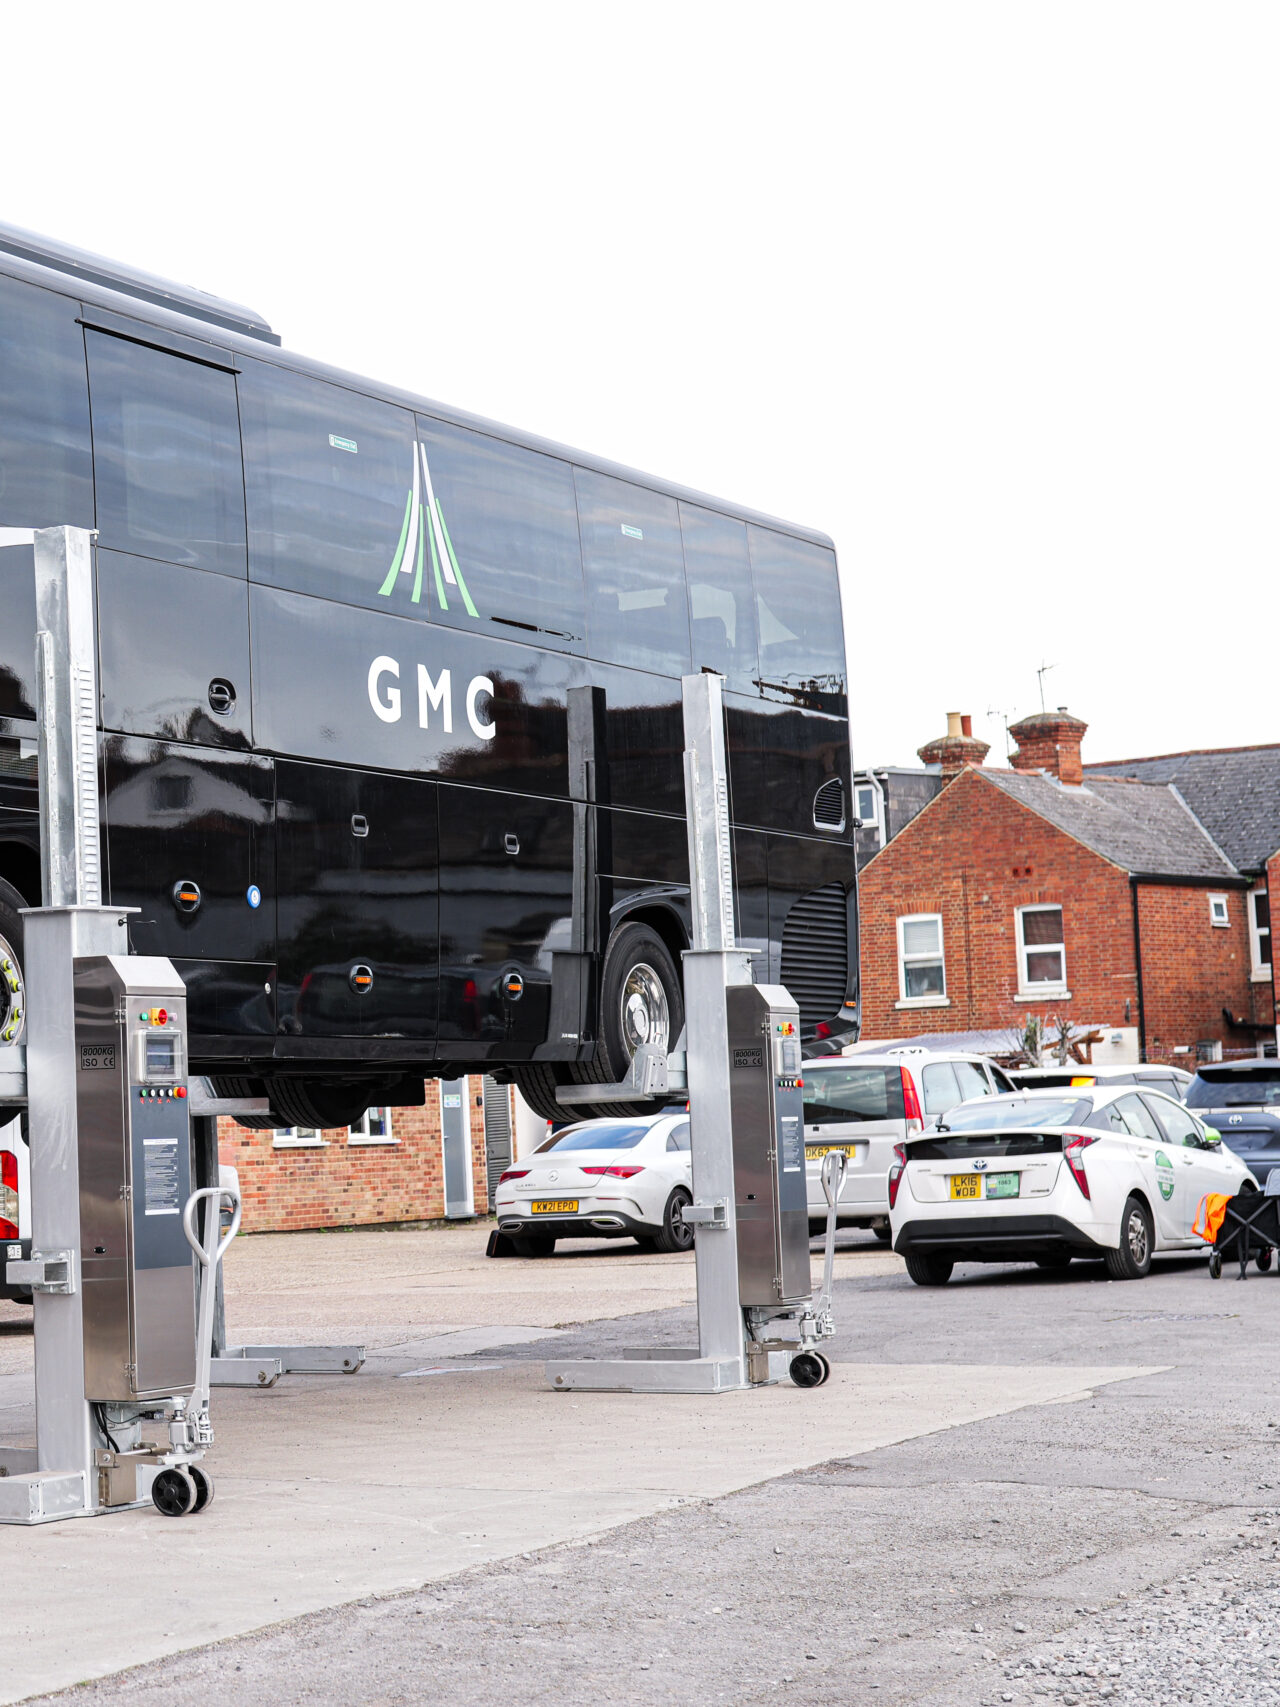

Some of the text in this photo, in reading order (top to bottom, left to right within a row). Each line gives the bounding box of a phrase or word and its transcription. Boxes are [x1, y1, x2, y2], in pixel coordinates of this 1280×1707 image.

[368, 655, 496, 740] GMC
[83, 1046, 113, 1056] 8000KG
[735, 1050, 761, 1058] 8000KG
[82, 1058, 98, 1067] ISO
[735, 1058, 748, 1066] ISO
[953, 1176, 978, 1188] LK16
[955, 1187, 977, 1198] WOB
[536, 1201, 574, 1212] KW21 EPO
